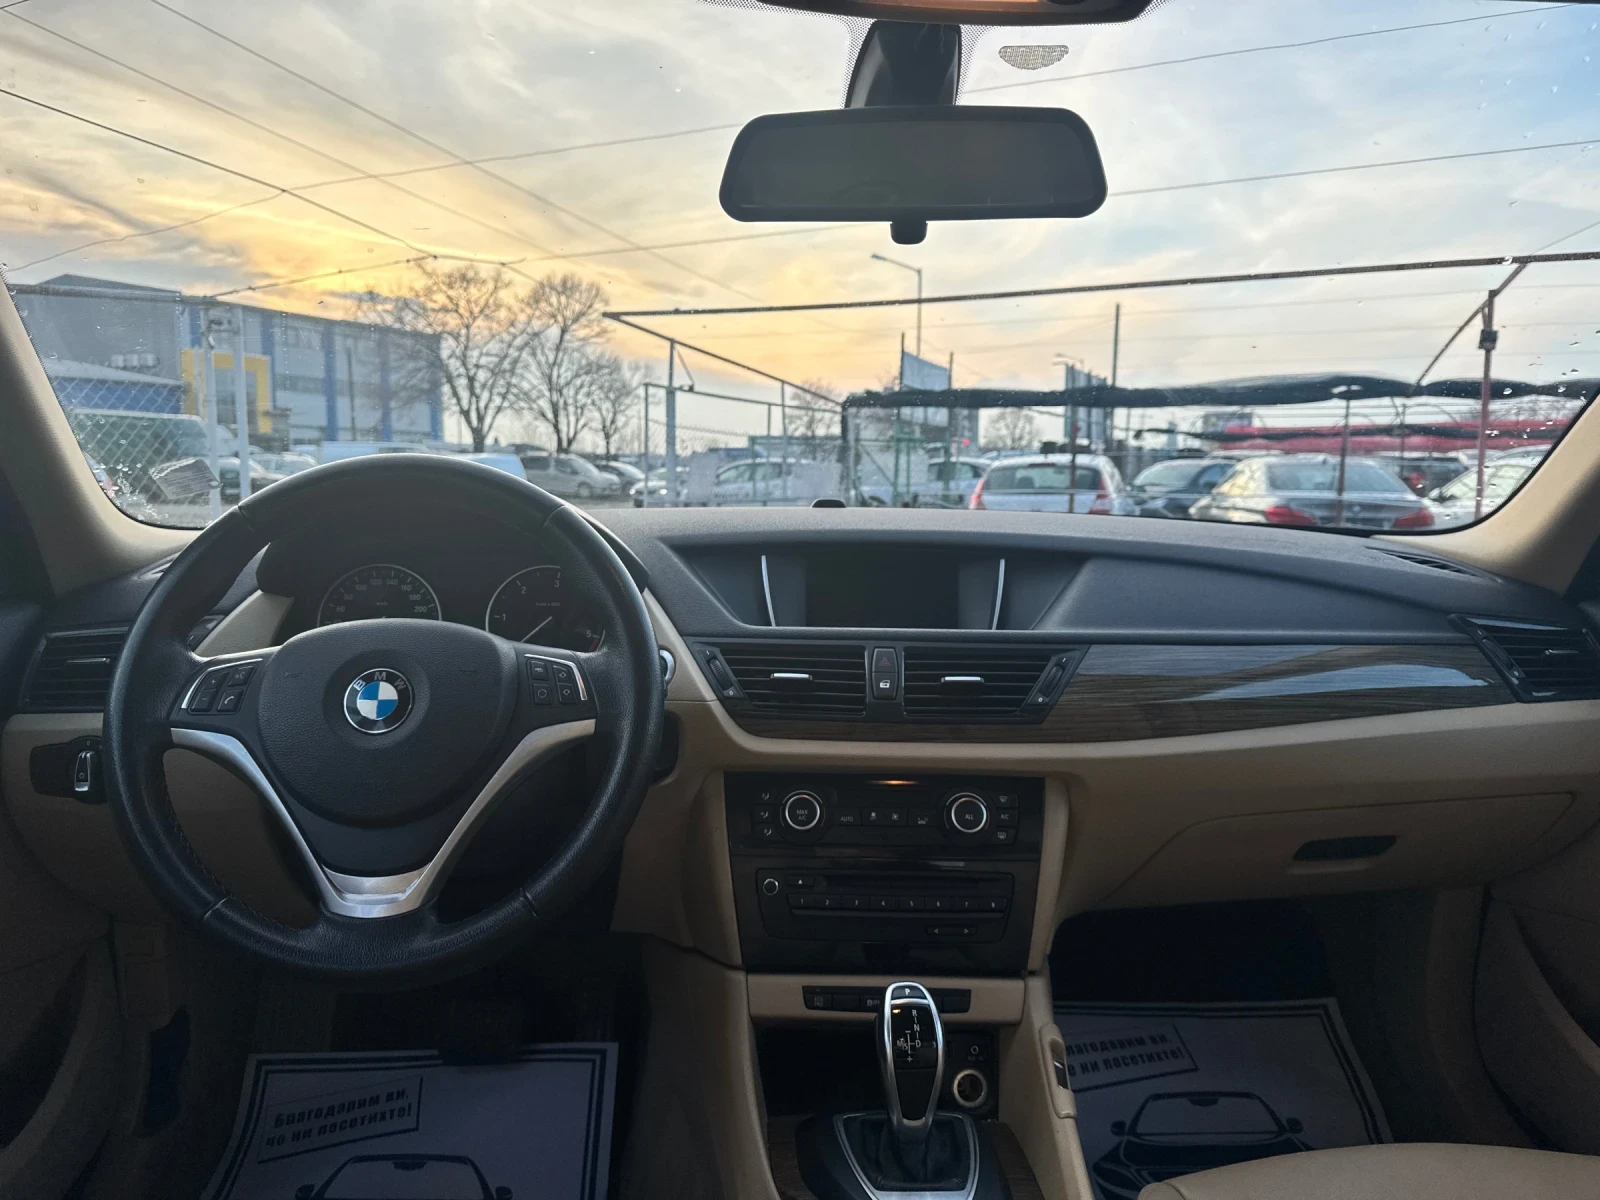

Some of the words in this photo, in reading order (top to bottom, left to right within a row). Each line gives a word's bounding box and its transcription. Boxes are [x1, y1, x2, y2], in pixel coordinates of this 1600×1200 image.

[521, 586, 527, 594] 2
[353, 672, 407, 691] BMW
[796, 808, 809, 816] MAX
